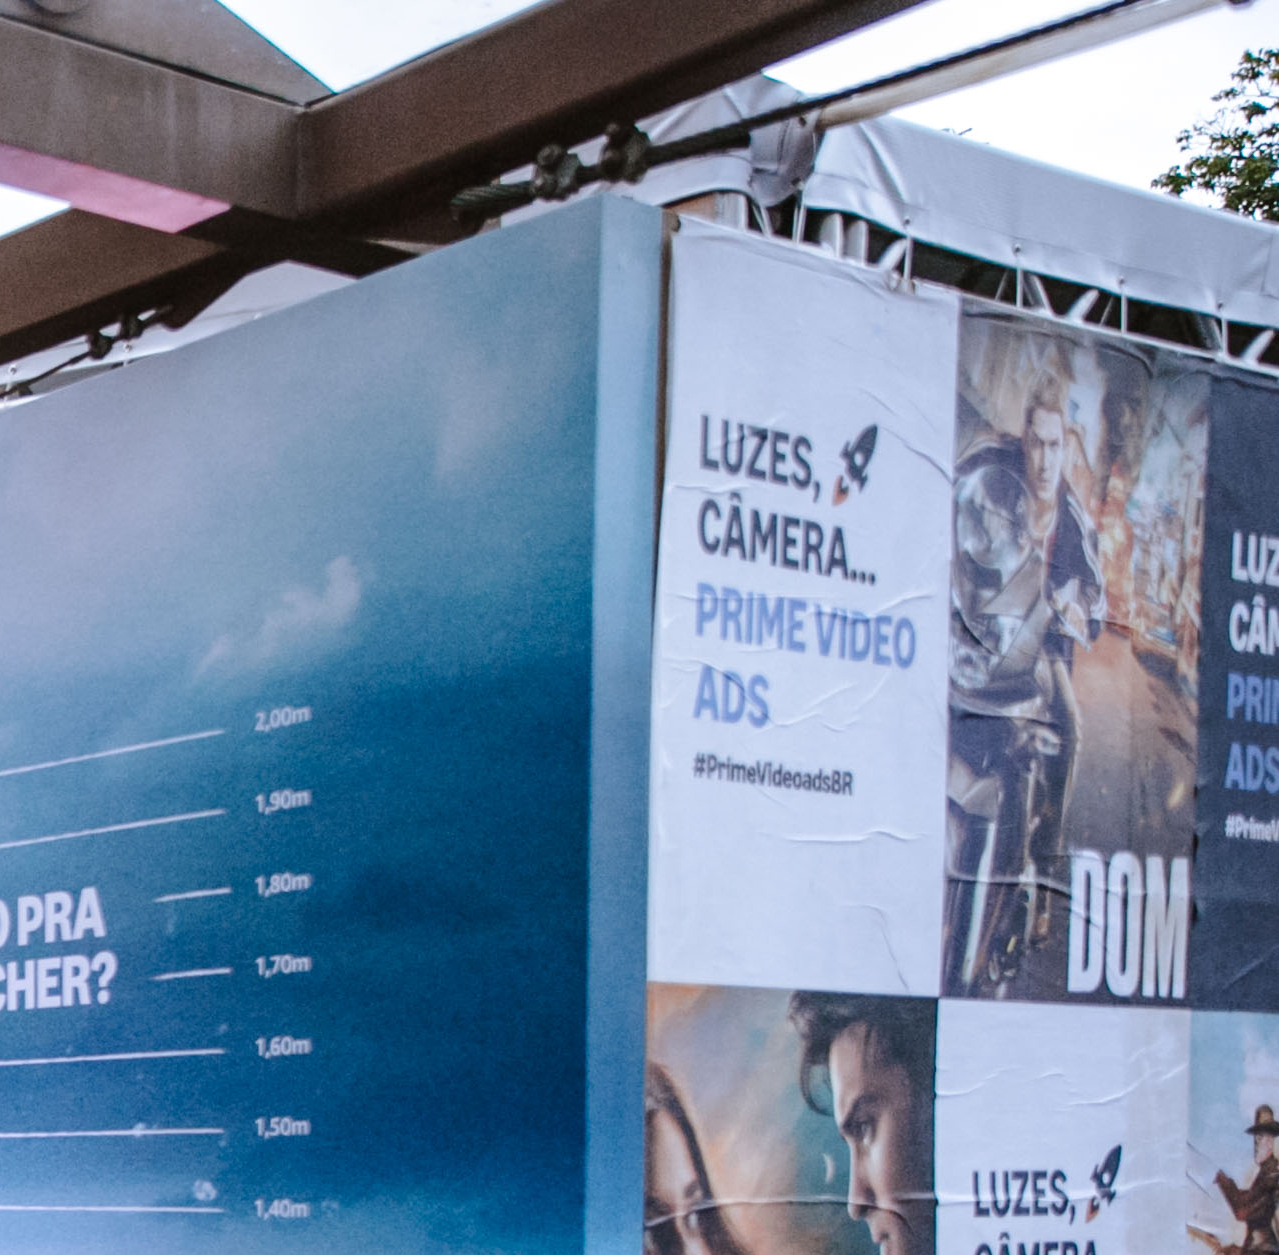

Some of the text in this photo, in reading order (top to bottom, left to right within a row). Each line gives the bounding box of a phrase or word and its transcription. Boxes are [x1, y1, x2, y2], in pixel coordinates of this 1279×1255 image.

[699, 414, 821, 503] LUZES,
[697, 491, 877, 586] CÂMERA...
[696, 582, 916, 669] PRIME VIDEO
[254, 706, 312, 732] 2,00m
[693, 664, 770, 728] ADS
[694, 752, 854, 796] #PrimeVideoadsBR
[1224, 741, 1279, 795] ADS
[255, 789, 312, 815] 1,90m
[255, 872, 313, 898] 1,80m
[17, 886, 107, 947] PRA
[1067, 848, 1190, 1000] DOM
[255, 954, 312, 979] 1,70m
[255, 1036, 312, 1059] 1,60m
[255, 1116, 311, 1139] 1,50m
[254, 1199, 310, 1220] 1,40m
[972, 1169, 1075, 1226] LUZES,
